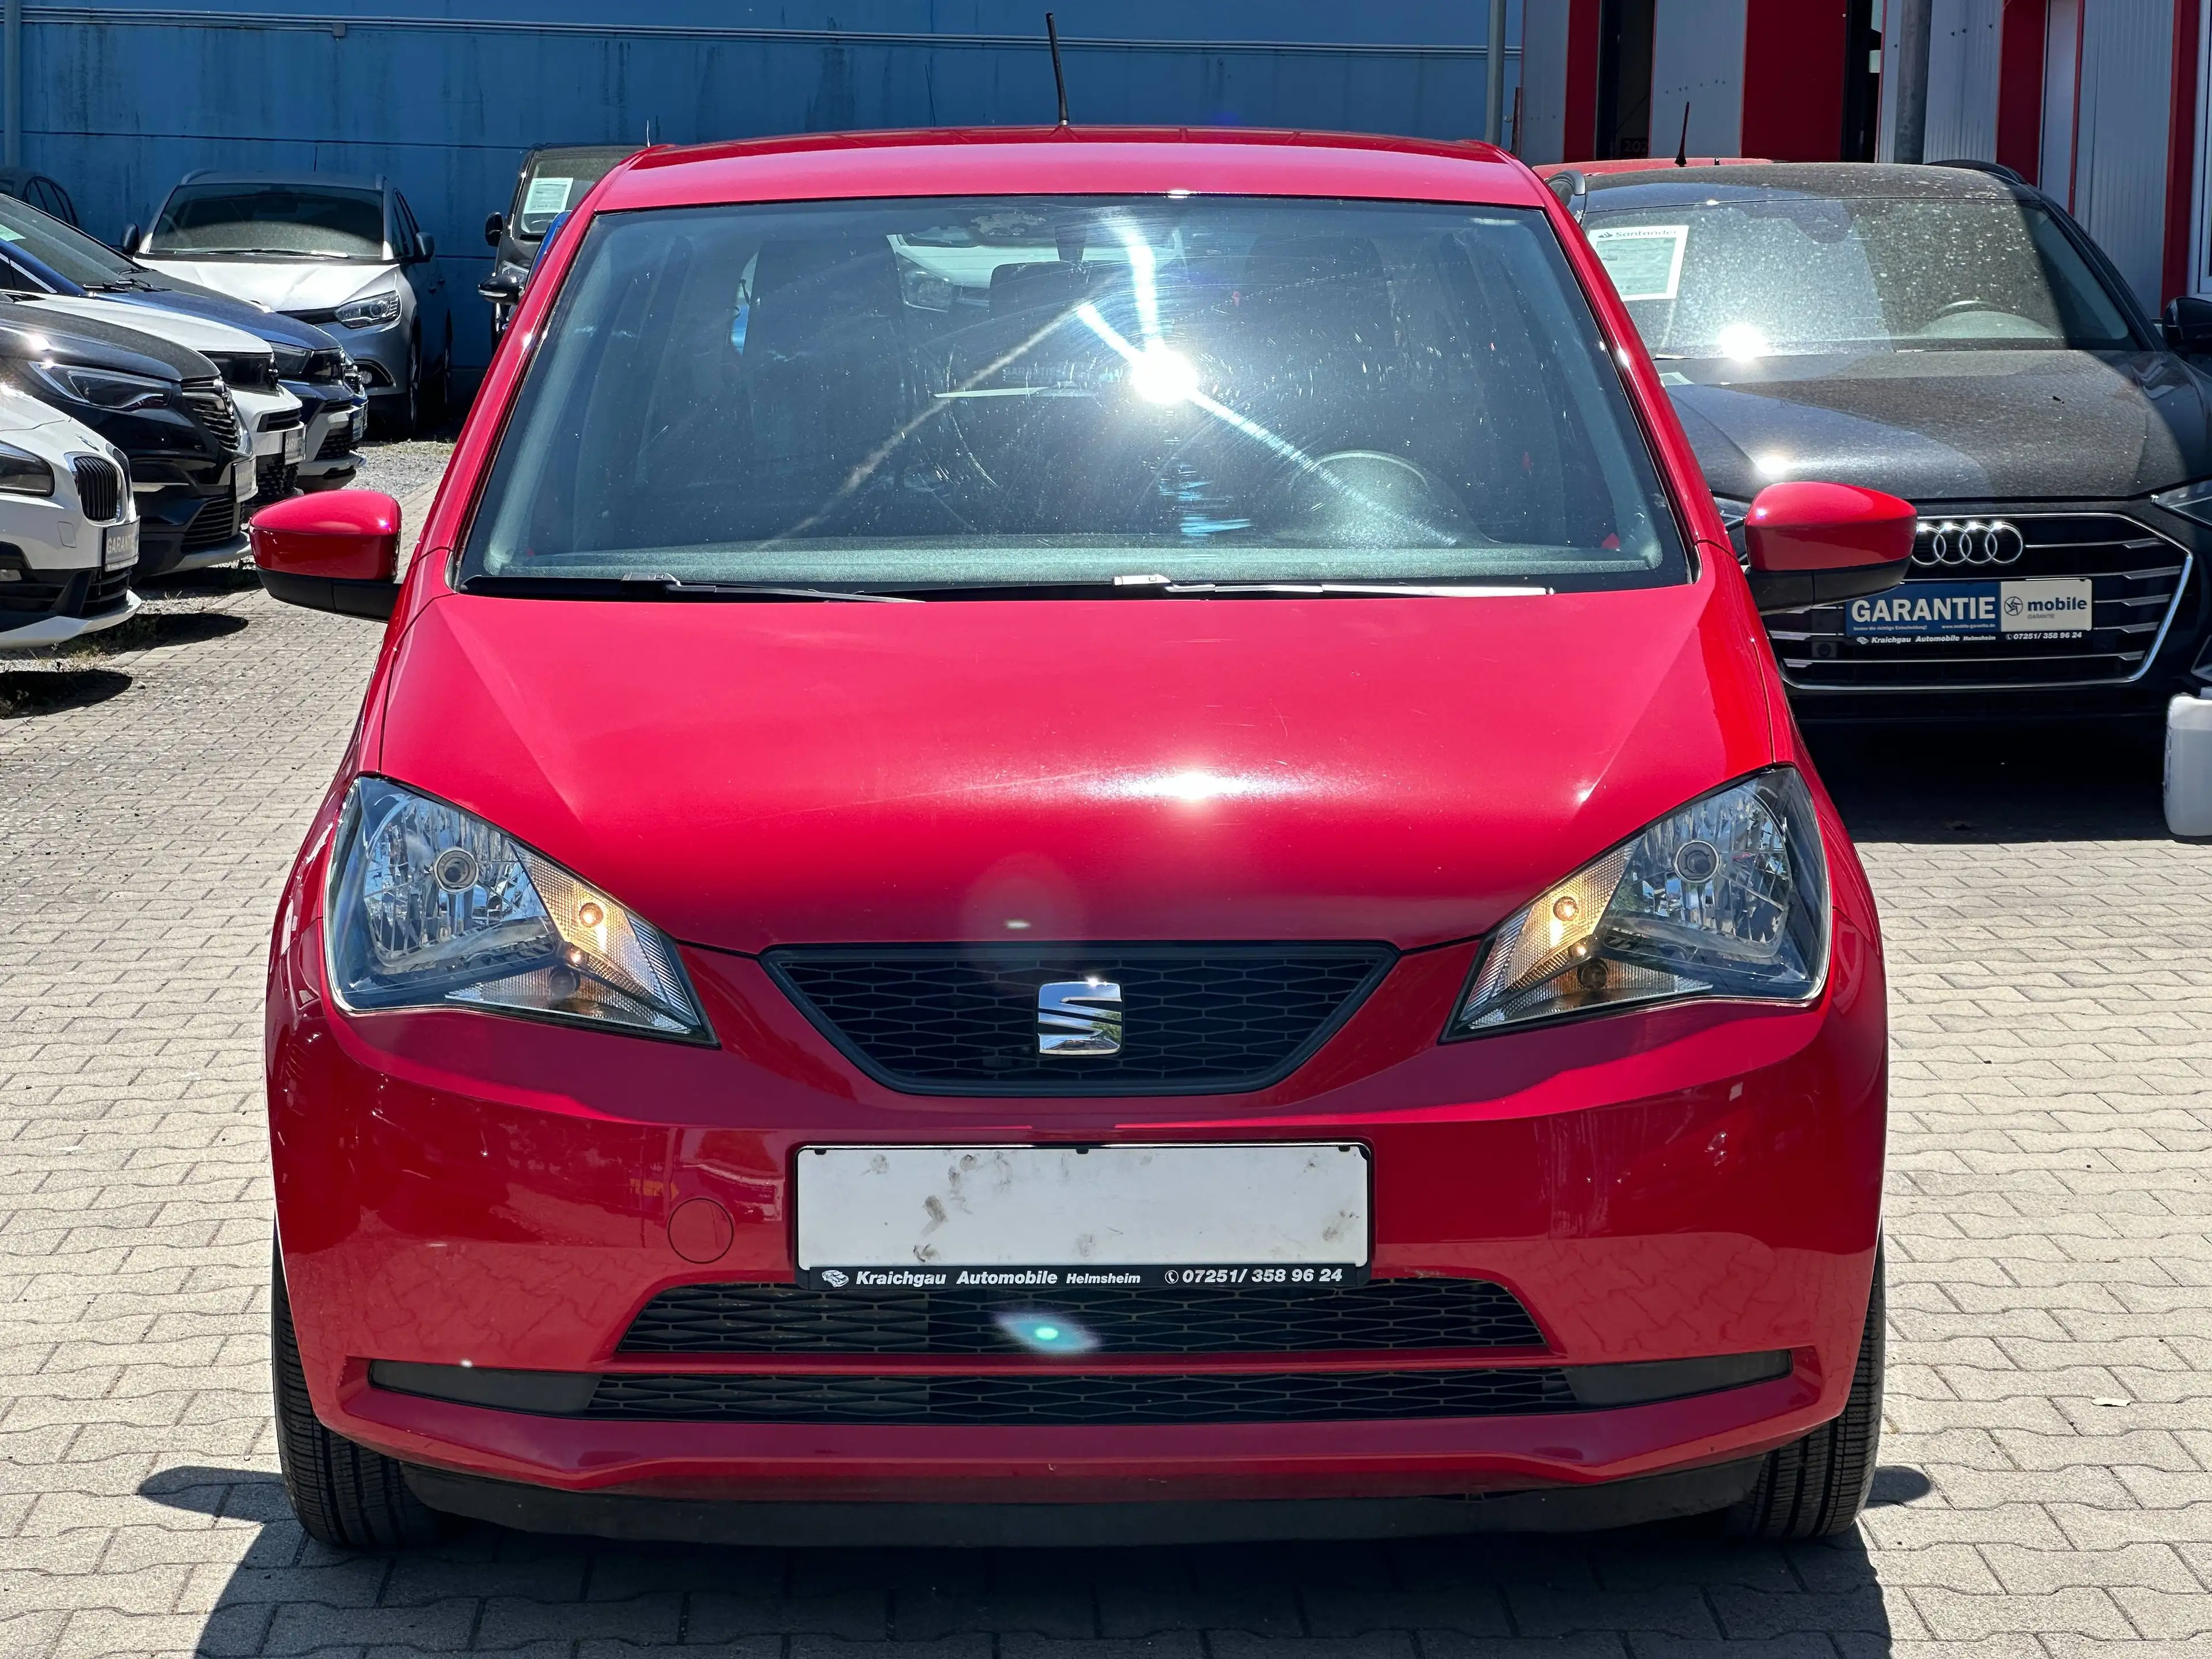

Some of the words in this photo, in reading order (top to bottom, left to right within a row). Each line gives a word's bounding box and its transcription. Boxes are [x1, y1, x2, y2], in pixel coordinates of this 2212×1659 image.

[1851, 596, 1996, 623] GARANTIE
[2027, 597, 2088, 612] mobile
[856, 1271, 946, 1287] Kraichgau
[956, 1270, 1058, 1285] Automobile
[1066, 1272, 1141, 1284] Helmsheim
[1182, 1269, 1248, 1283] 07251/
[1251, 1269, 1286, 1283] 358
[1291, 1269, 1315, 1282] 96
[1319, 1268, 1343, 1282] 24
